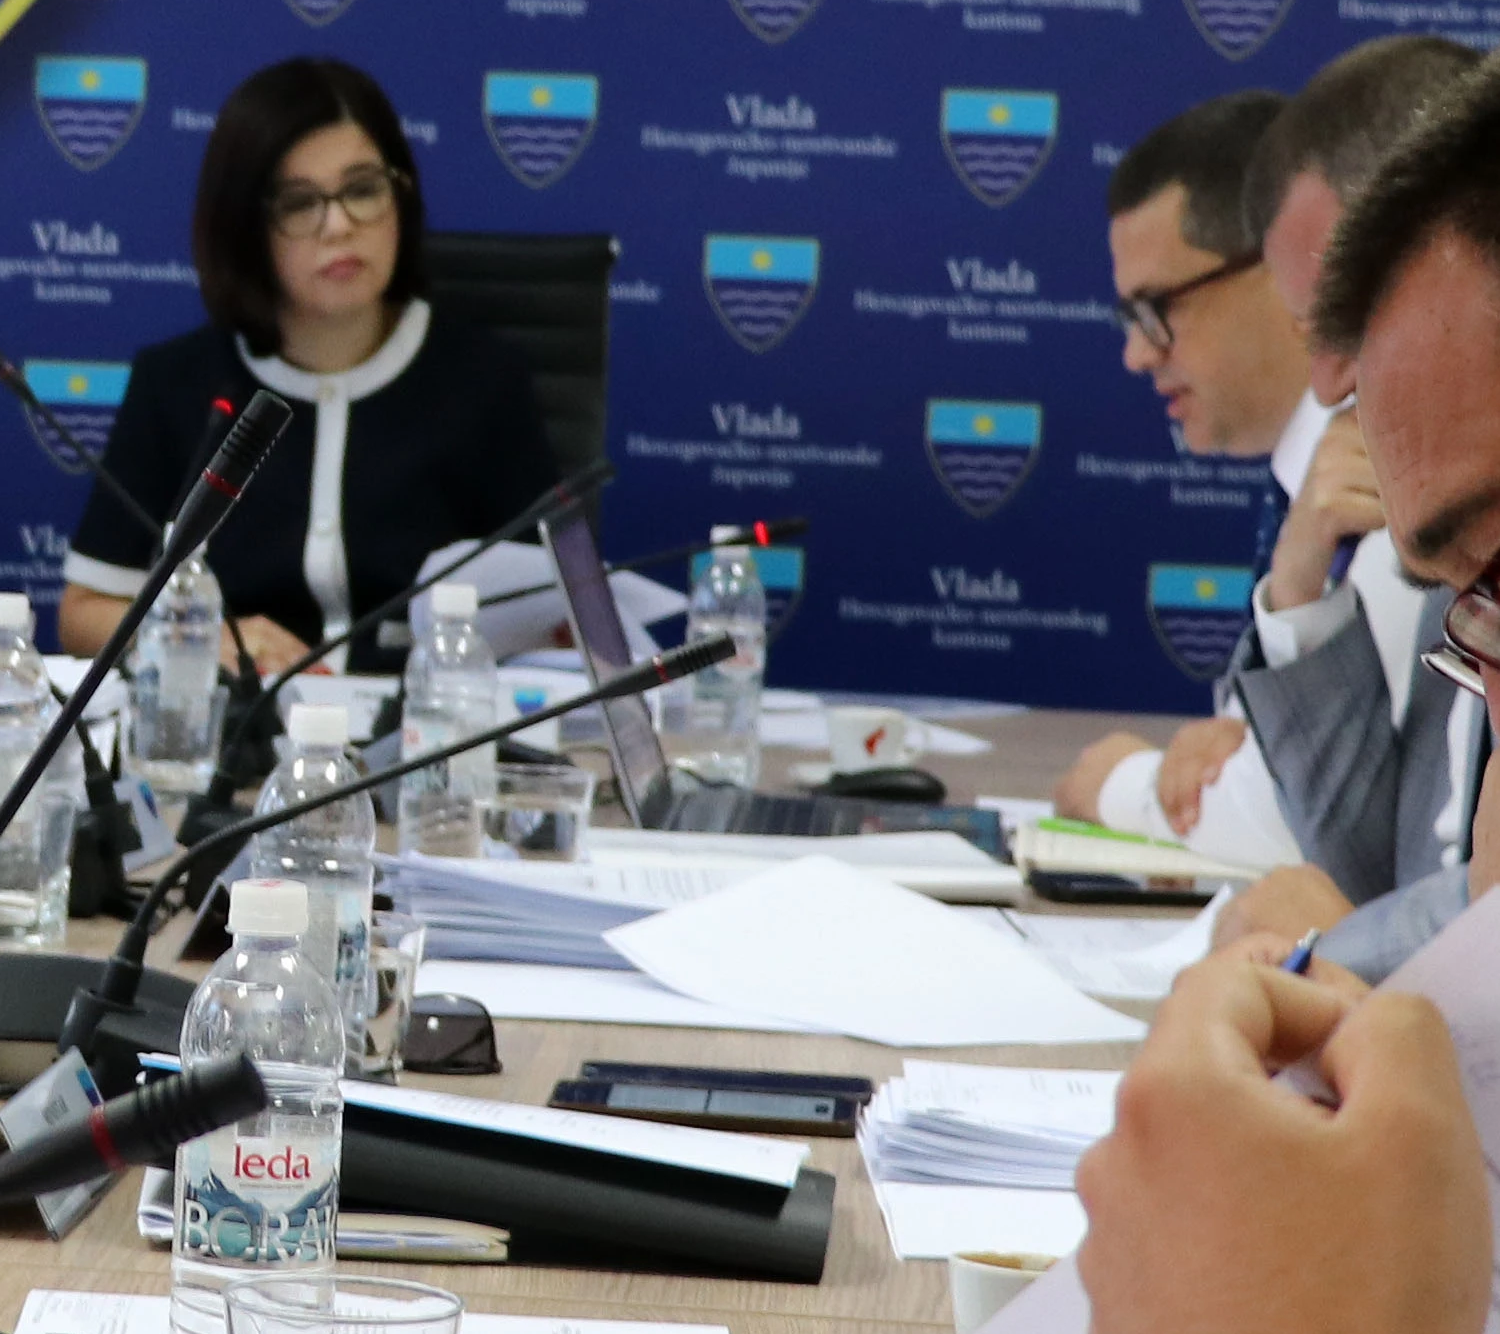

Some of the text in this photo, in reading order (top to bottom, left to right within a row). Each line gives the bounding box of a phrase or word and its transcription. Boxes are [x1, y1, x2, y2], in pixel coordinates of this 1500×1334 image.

[727, 94, 817, 129] Vlada
[32, 220, 120, 256] Vlada
[946, 258, 1037, 294] Vlada
[712, 403, 801, 438] Vlada
[931, 568, 1021, 602] Vlada
[233, 1144, 312, 1180] leda
